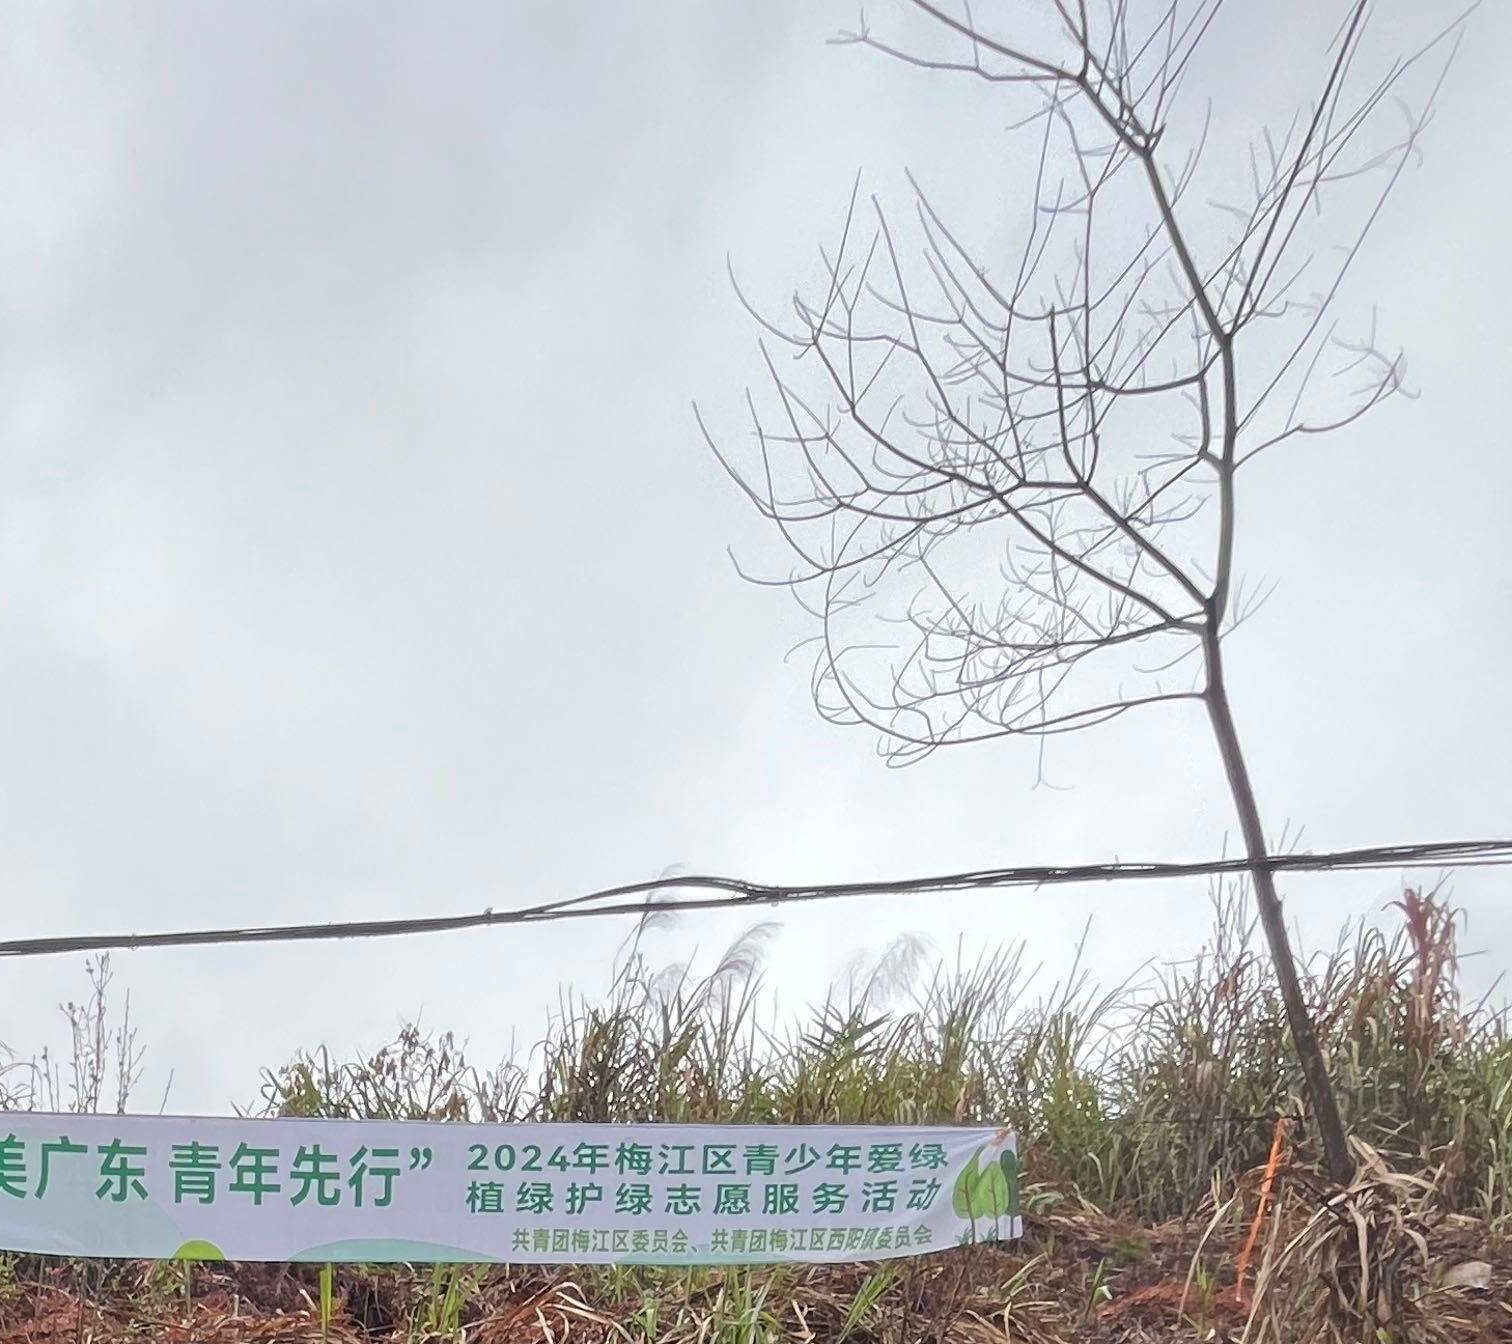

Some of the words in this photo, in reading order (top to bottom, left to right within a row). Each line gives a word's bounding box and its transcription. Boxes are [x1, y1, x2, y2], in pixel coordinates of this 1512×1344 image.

[168, 1141, 433, 1207] 青年先行”
[466, 1141, 949, 1176] 2024年梅江区青少年爱绿
[466, 1179, 942, 1216] 植绿护绿志愿服务活动
